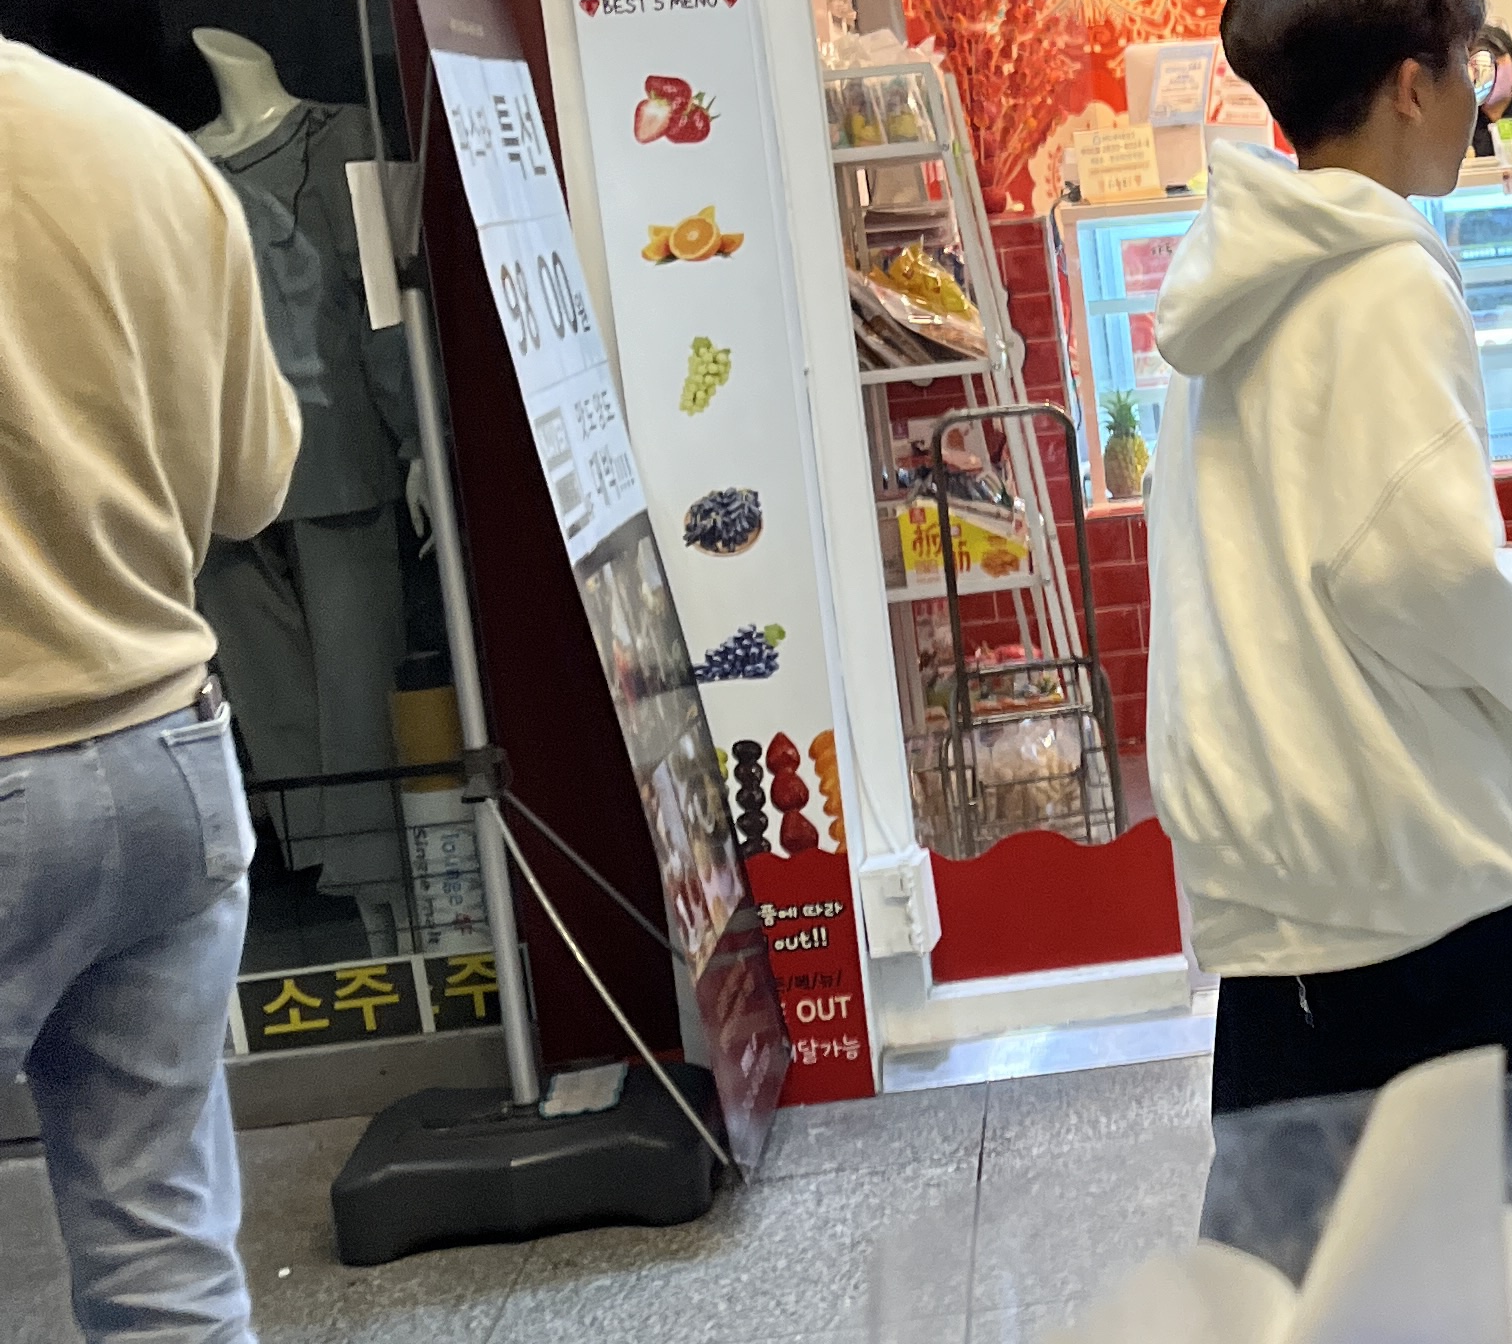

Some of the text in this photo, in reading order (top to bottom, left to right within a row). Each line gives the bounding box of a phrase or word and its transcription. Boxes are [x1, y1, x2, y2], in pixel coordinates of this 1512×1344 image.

[493, 94, 548, 181] 특선
[801, 901, 844, 918] 따라
[774, 926, 828, 952] out!!
[262, 963, 401, 1037] 소주
[431, 953, 501, 1019] 주
[796, 995, 853, 1024] OUT
[789, 1034, 861, 1065] 달가능
